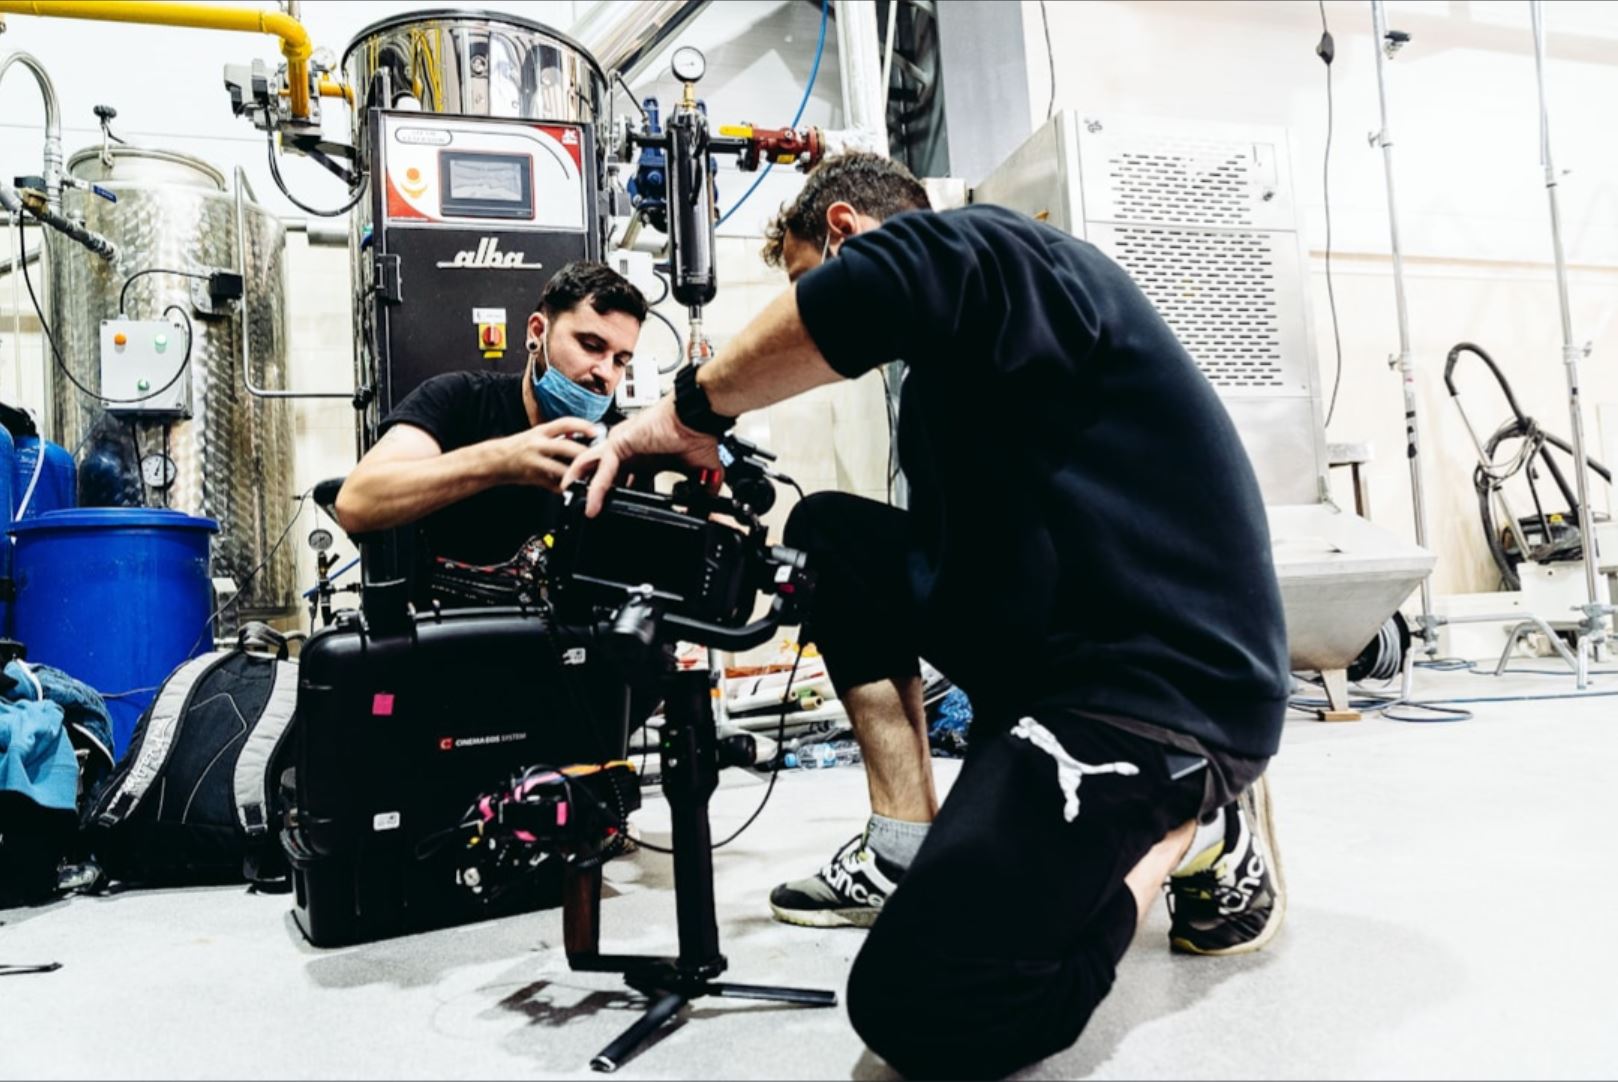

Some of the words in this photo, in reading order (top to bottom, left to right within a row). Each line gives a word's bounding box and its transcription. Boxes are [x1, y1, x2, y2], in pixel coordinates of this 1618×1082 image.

[454, 237, 525, 268] alba
[455, 738, 485, 747] CINEMA
[486, 735, 500, 744] EOS
[502, 732, 526, 742] SYSTEM
